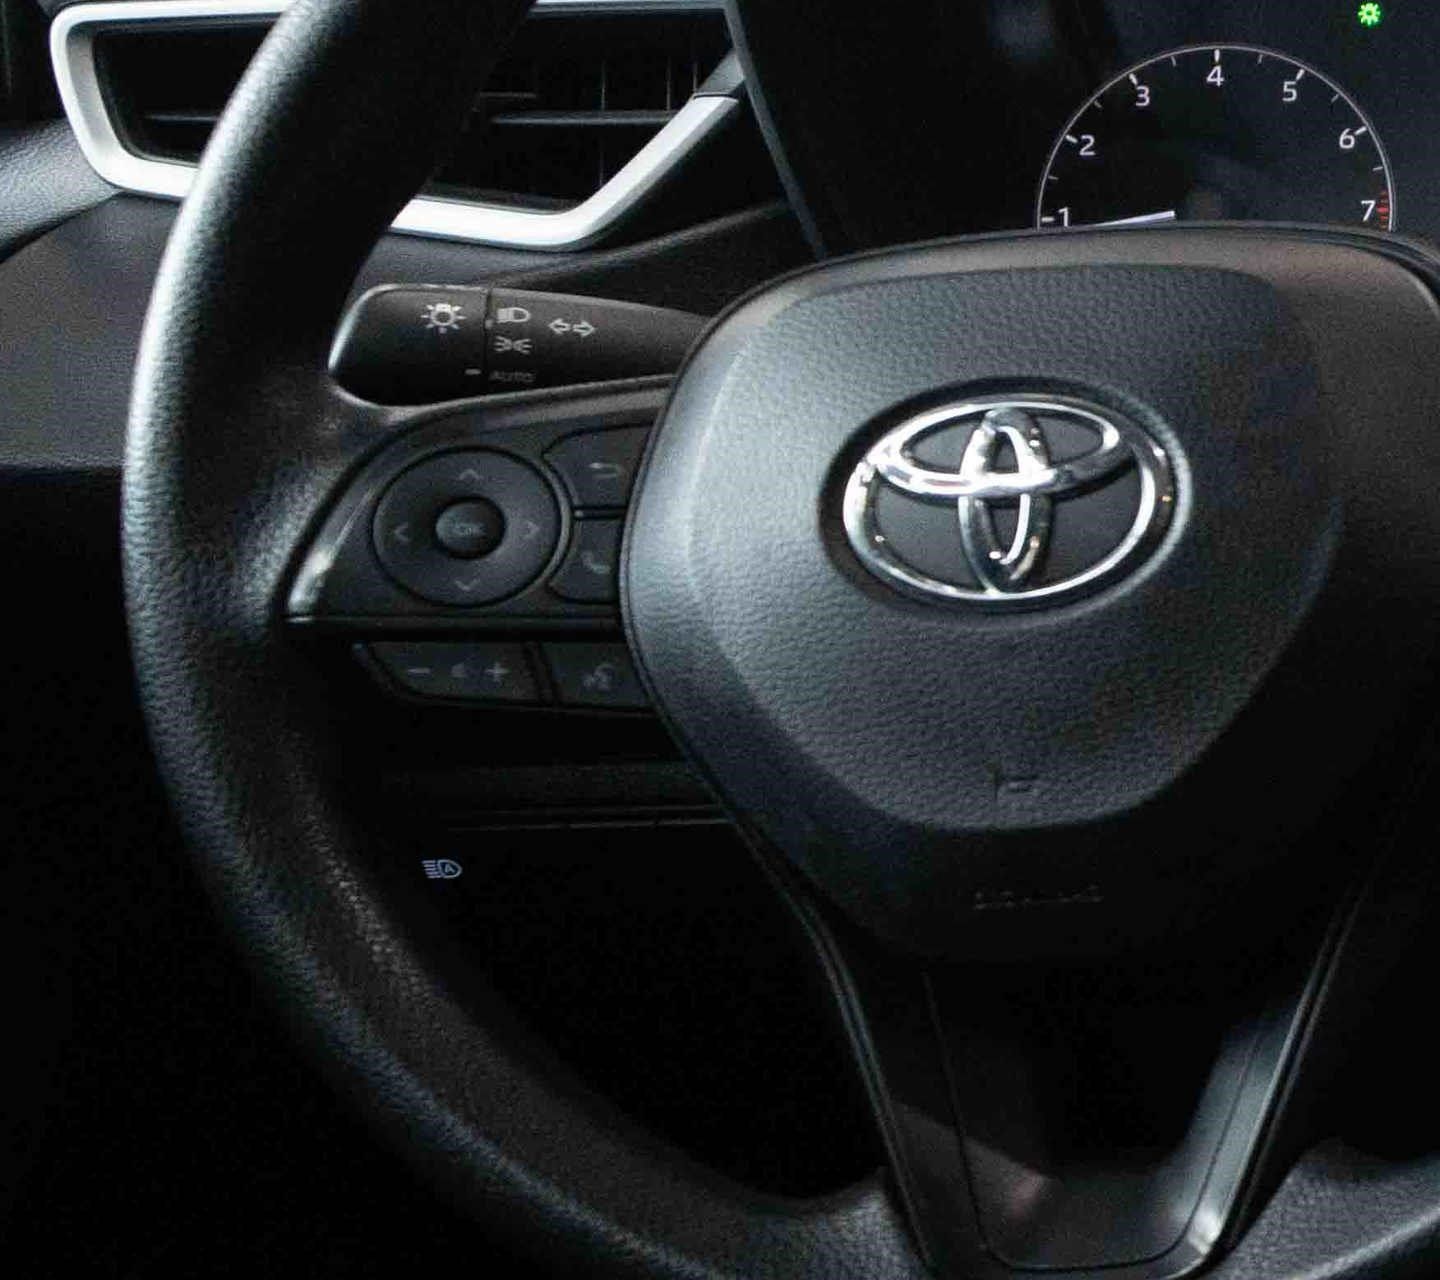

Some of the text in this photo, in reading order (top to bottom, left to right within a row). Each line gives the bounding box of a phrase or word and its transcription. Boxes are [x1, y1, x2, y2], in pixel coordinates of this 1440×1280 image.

[1205, 65, 1225, 87] 4
[1135, 86, 1150, 106] 3
[1282, 81, 1298, 102] 5
[1079, 135, 1096, 156] 2
[1338, 128, 1355, 149] 6
[1058, 206, 1070, 227] 1
[1360, 200, 1377, 222] 7
